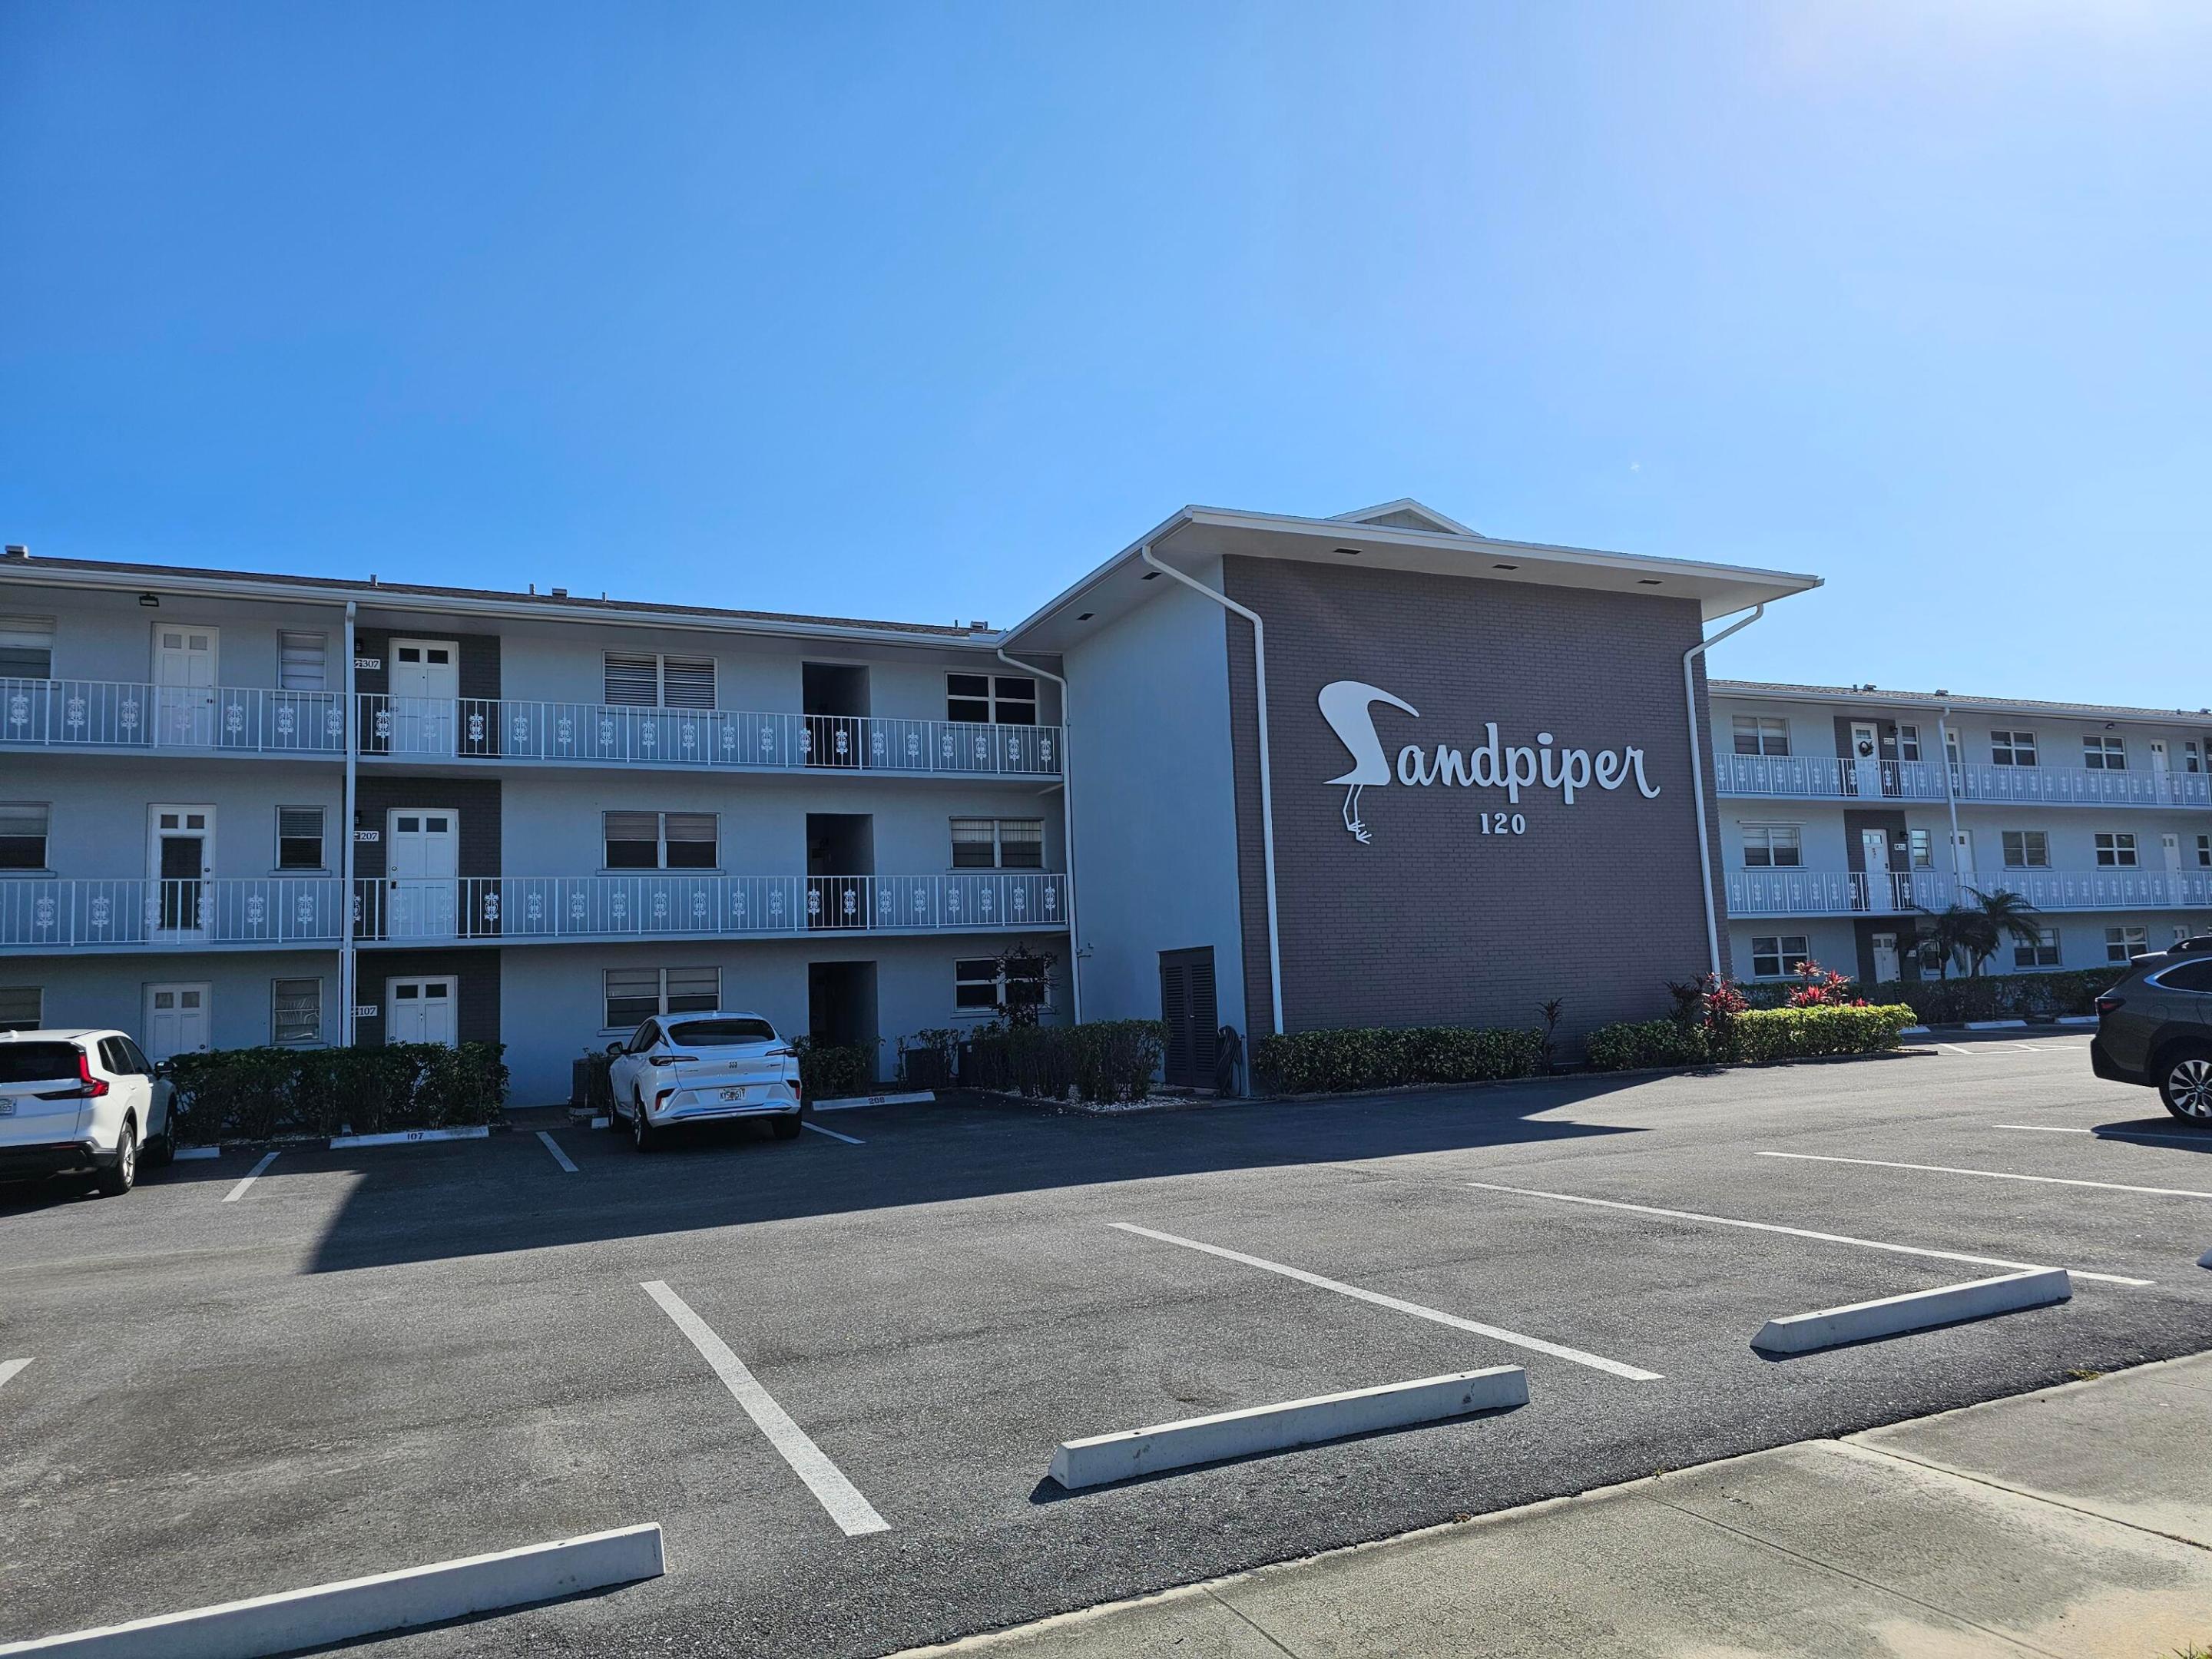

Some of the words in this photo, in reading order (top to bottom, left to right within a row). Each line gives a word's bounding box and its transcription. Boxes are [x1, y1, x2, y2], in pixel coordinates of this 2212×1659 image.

[1318, 680, 1661, 805] Sandpiper
[1480, 813, 1526, 835] 120
[407, 1132, 424, 1141] 107
